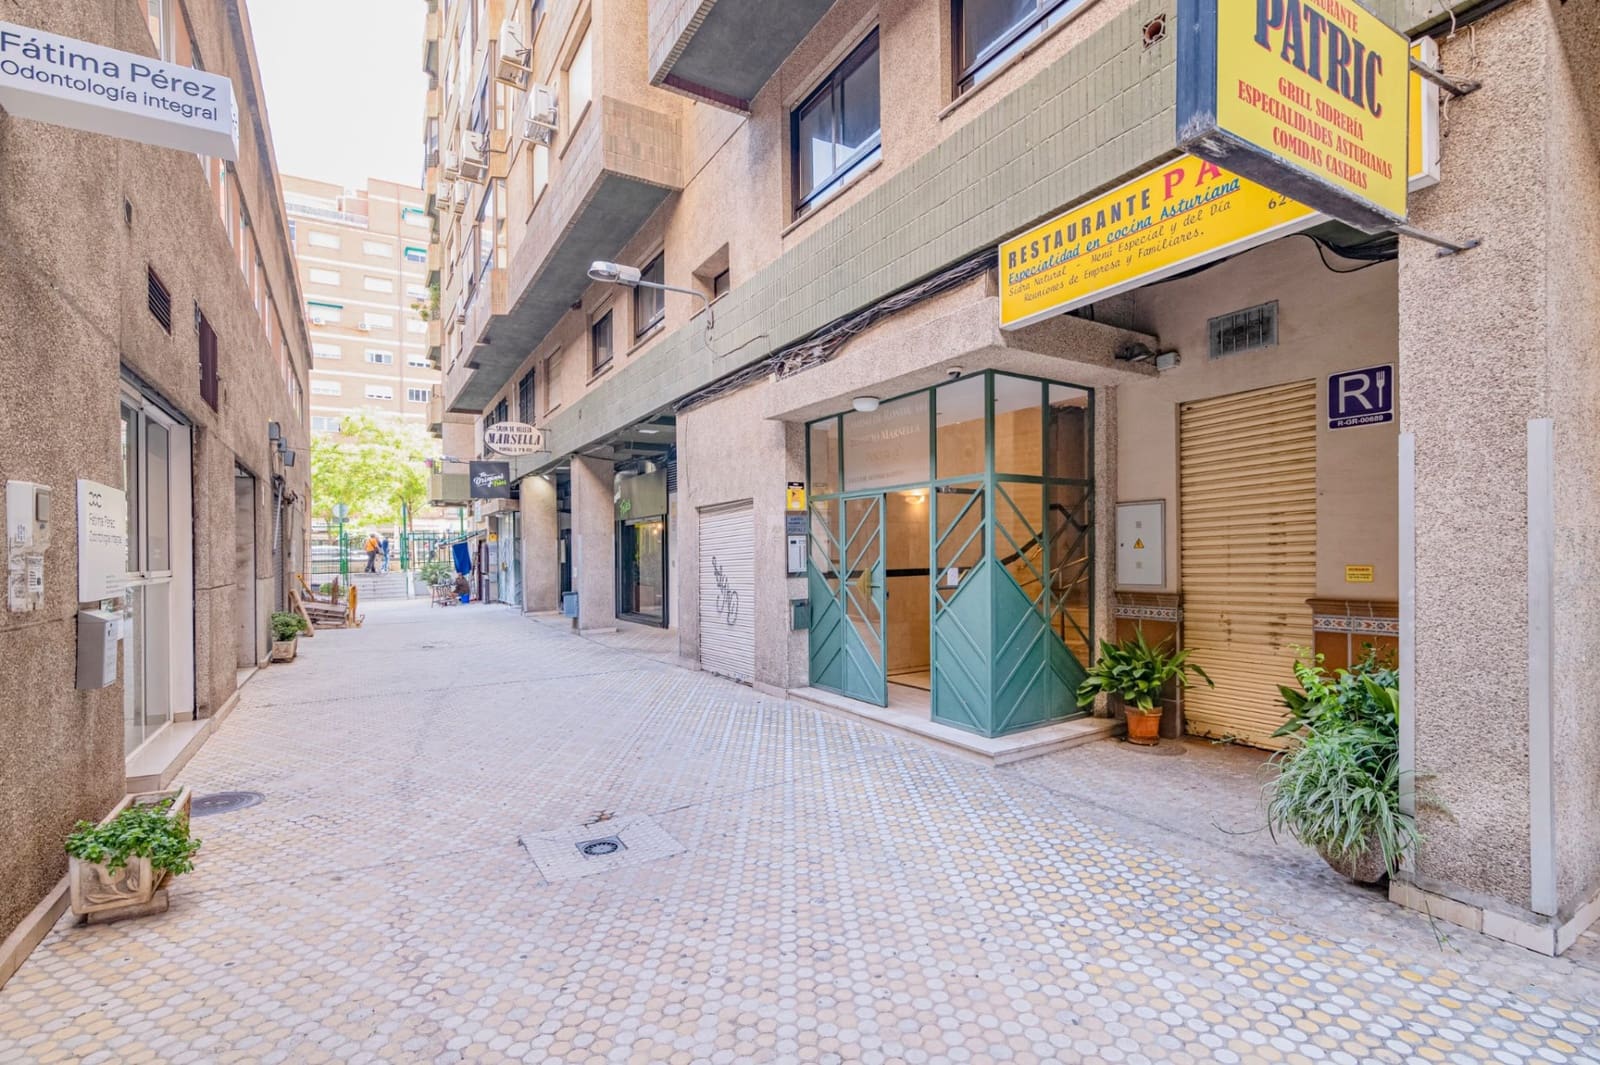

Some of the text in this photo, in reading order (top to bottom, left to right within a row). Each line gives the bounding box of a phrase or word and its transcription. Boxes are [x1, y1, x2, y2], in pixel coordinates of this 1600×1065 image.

[0, 31, 217, 101] Fátima Pérez
[0, 59, 218, 121] Odontología integral
[1253, 0, 1383, 119] PATRIC
[1237, 79, 1393, 180] ESPECIALIDADES ASTURIANAS
[1278, 76, 1364, 142] GRILL SIDRERÍA
[1272, 126, 1368, 190] COMIDAS CASERAS
[1008, 188, 1151, 270] RESTAURANTE
[1008, 177, 1240, 286] Especialidad en cocina Asturiana
[1008, 284, 1031, 297] Sidra
[1034, 265, 1067, 285] Natural
[1118, 225, 1164, 252] Especial
[1170, 223, 1177, 235] y
[1183, 209, 1203, 227] del
[1024, 228, 1205, 302] Reuniones de Empresa y Familiares.
[1338, 373, 1373, 414] R
[488, 433, 541, 446] MARSELLA
